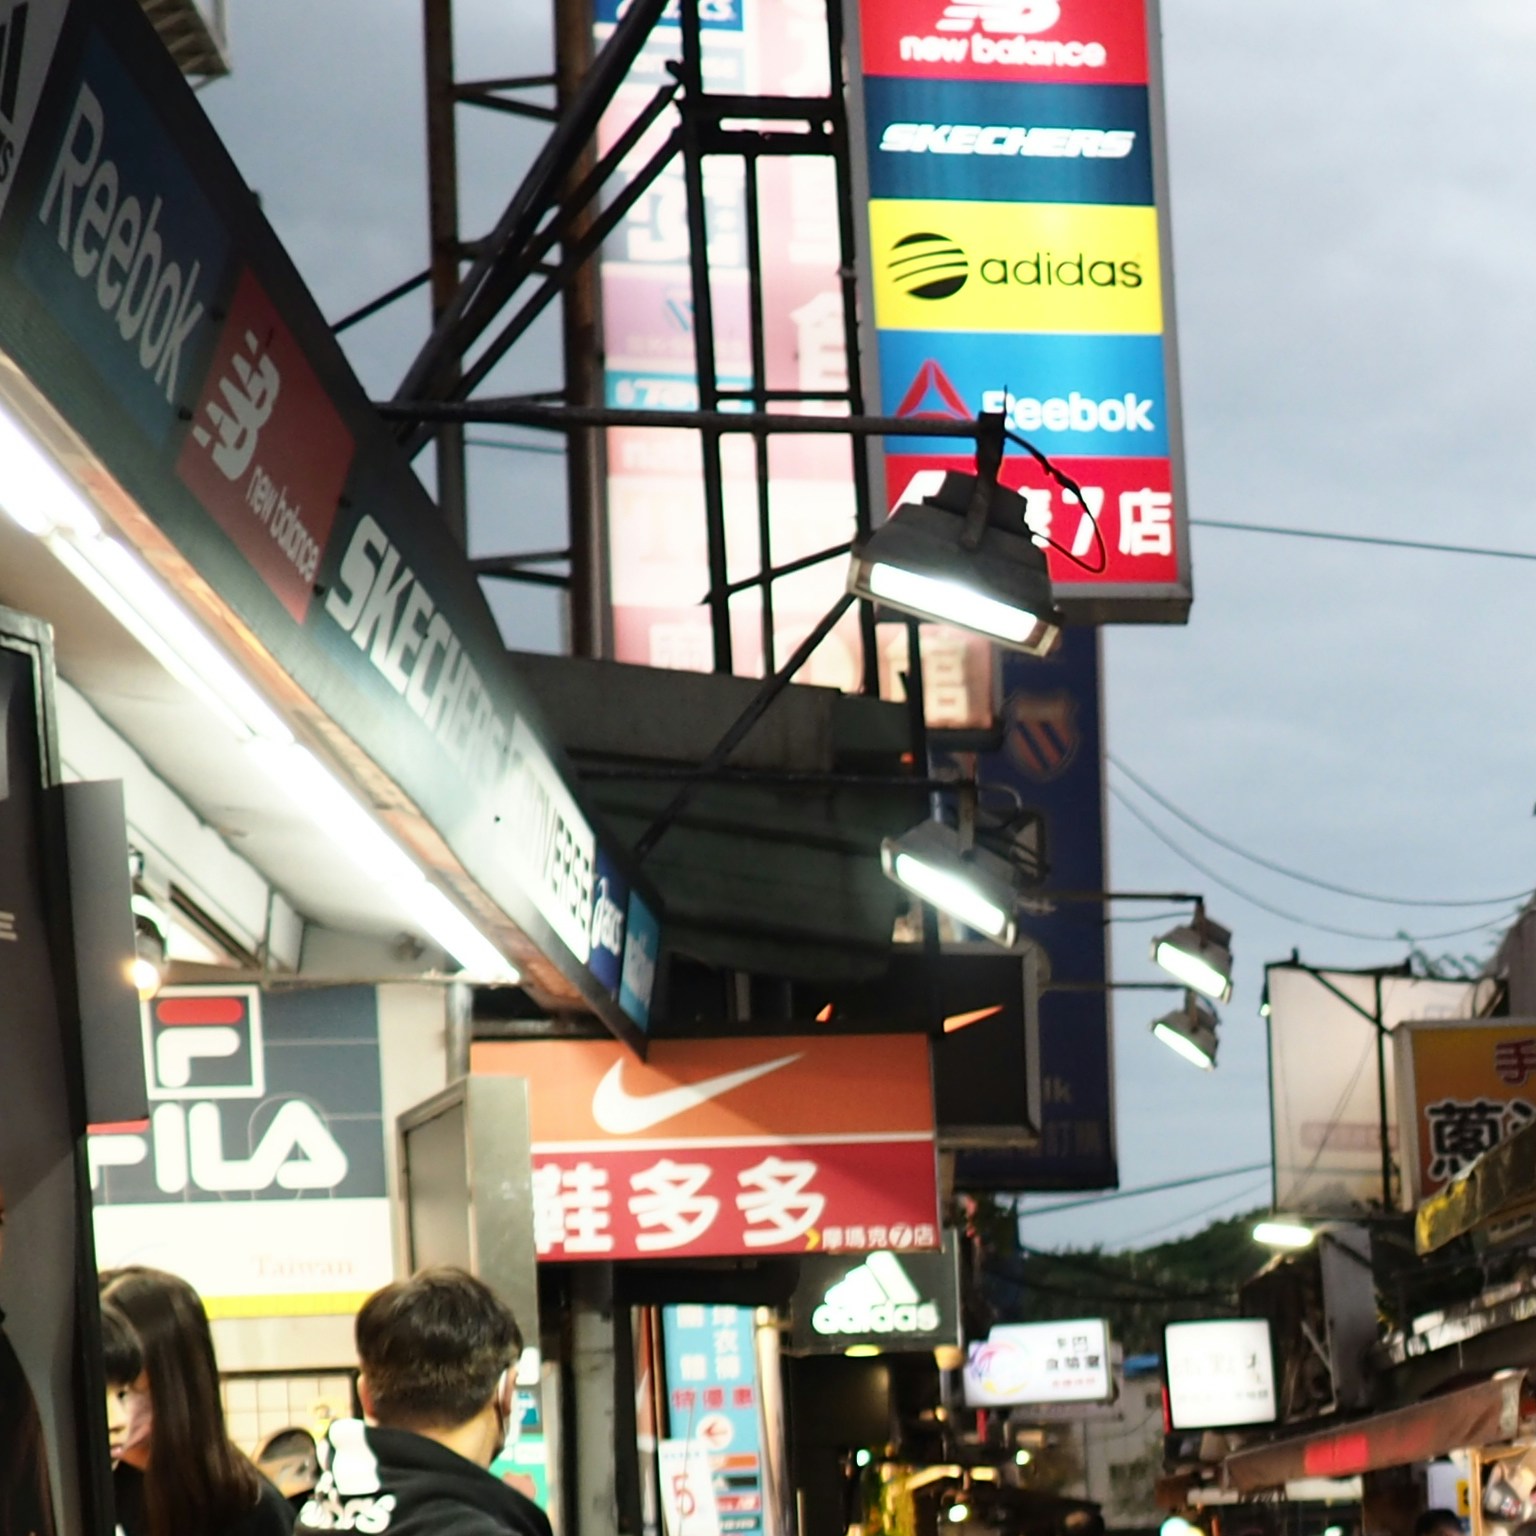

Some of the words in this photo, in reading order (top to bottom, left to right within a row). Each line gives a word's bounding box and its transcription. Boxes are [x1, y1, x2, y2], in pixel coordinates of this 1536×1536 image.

[900, 40, 963, 63] new
[970, 34, 1106, 67] balance
[880, 124, 1136, 159] SKECHERS
[39, 82, 204, 404] Reebok
[980, 252, 1143, 289] adidas
[246, 466, 277, 527] new
[268, 500, 321, 584] balance
[325, 514, 508, 790] SKECHERS
[88, 1101, 348, 1192] FILA
[534, 1156, 827, 1254] 鞋多多
[812, 1300, 940, 1334] adidas
